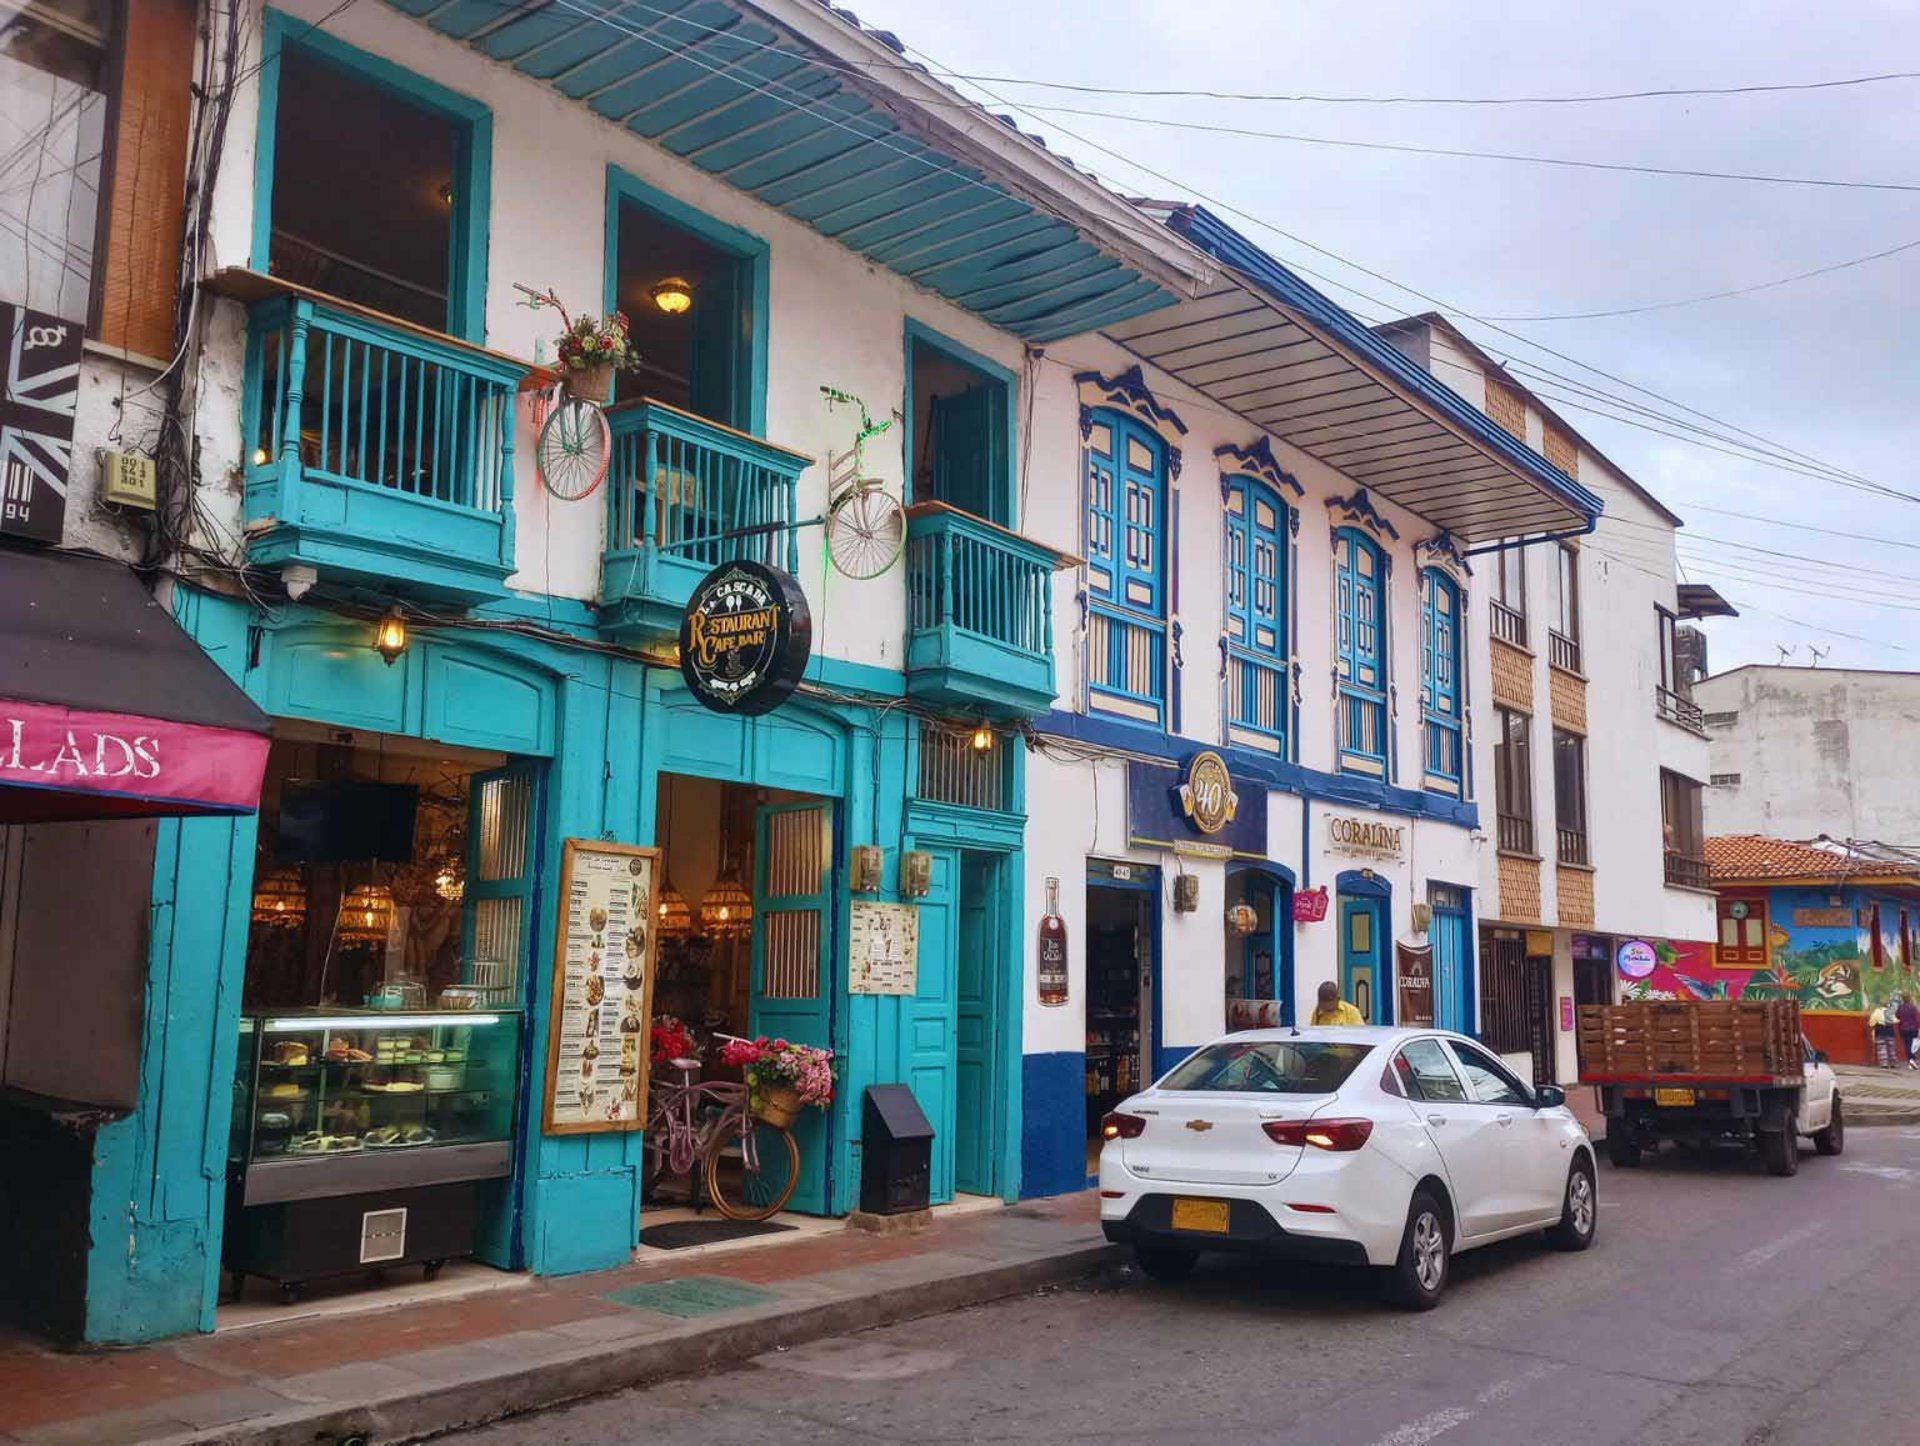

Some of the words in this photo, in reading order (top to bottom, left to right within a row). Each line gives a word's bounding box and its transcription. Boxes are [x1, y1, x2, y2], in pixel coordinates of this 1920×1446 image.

[5, 503, 30, 522] 94
[717, 582, 767, 607] CASCADA
[0, 719, 161, 779] LADS
[1196, 779, 1222, 815] 40
[1331, 817, 1402, 851] CORALINA
